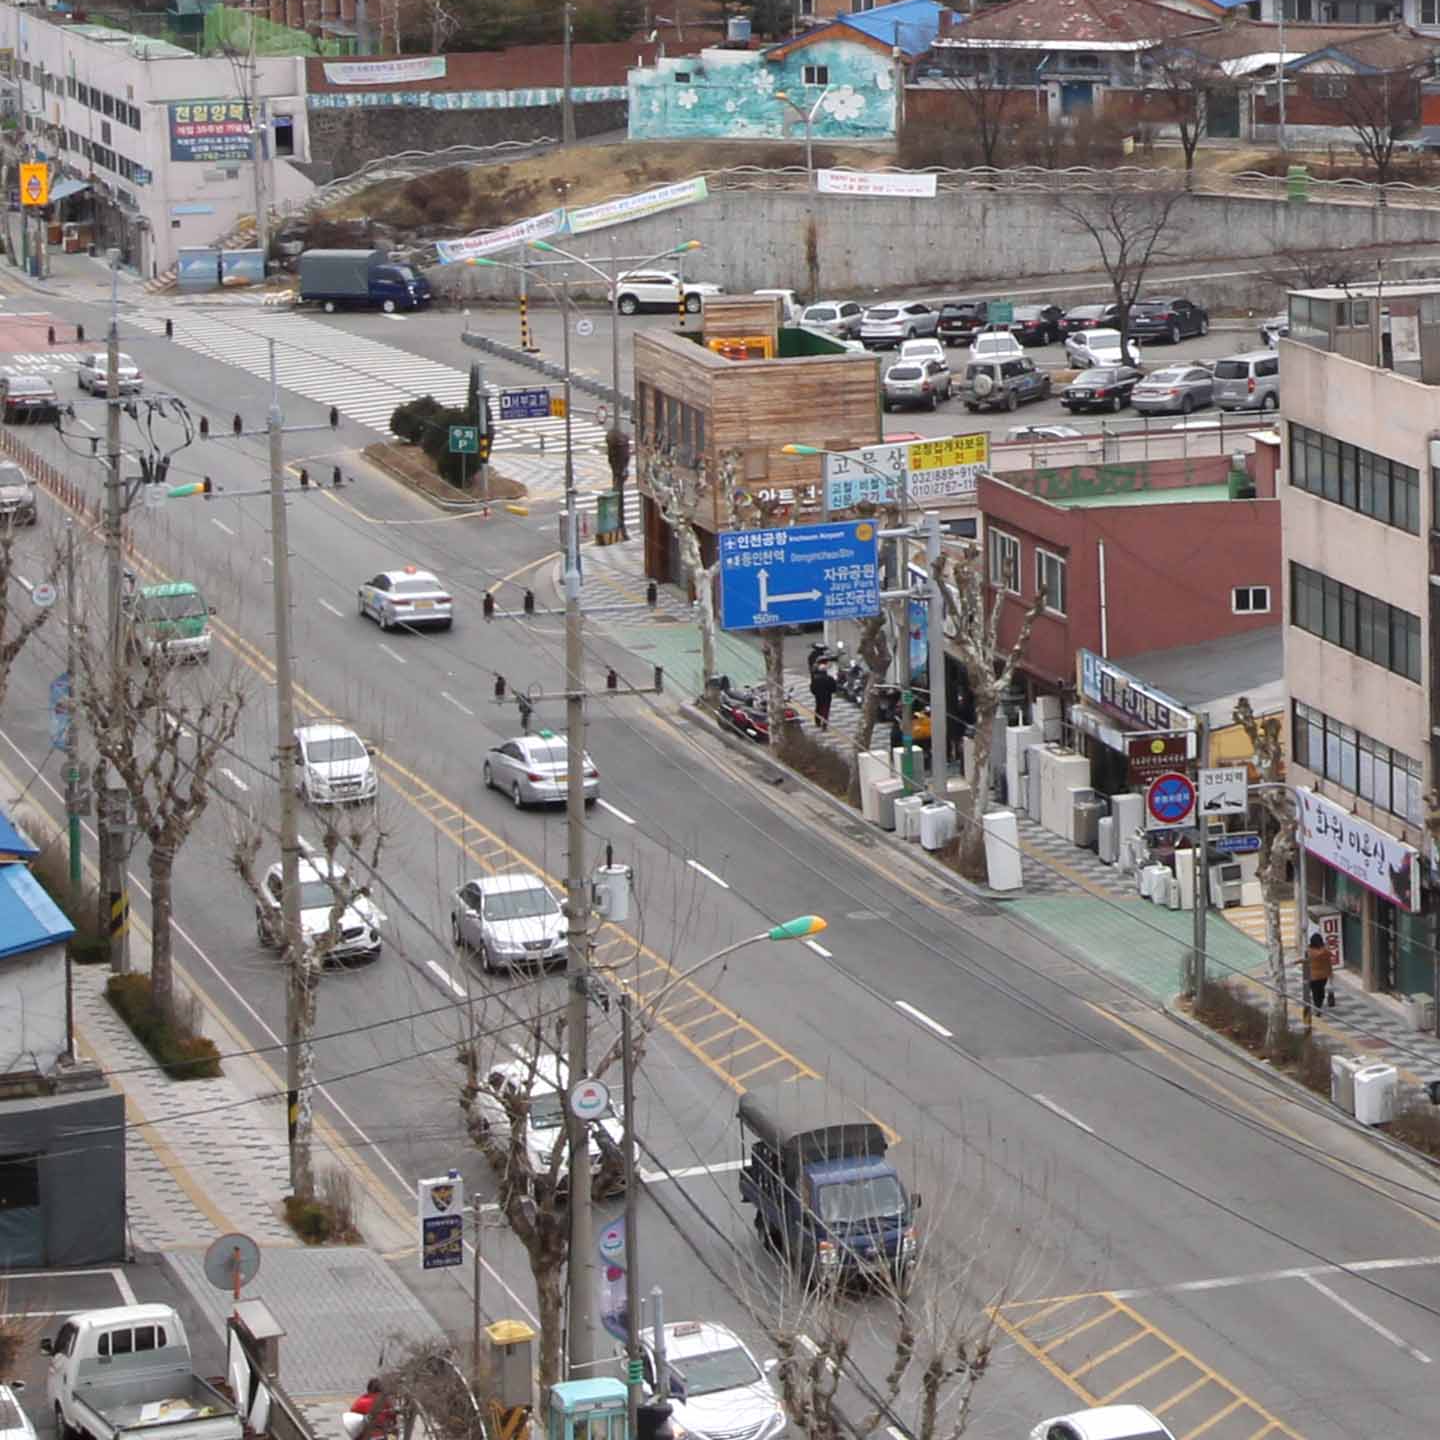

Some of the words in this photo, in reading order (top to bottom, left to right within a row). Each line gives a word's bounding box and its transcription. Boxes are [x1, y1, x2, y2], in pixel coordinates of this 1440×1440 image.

[737, 531, 788, 549] 인천공항
[741, 549, 785, 566] 동인천역
[823, 564, 875, 581] 자유공원
